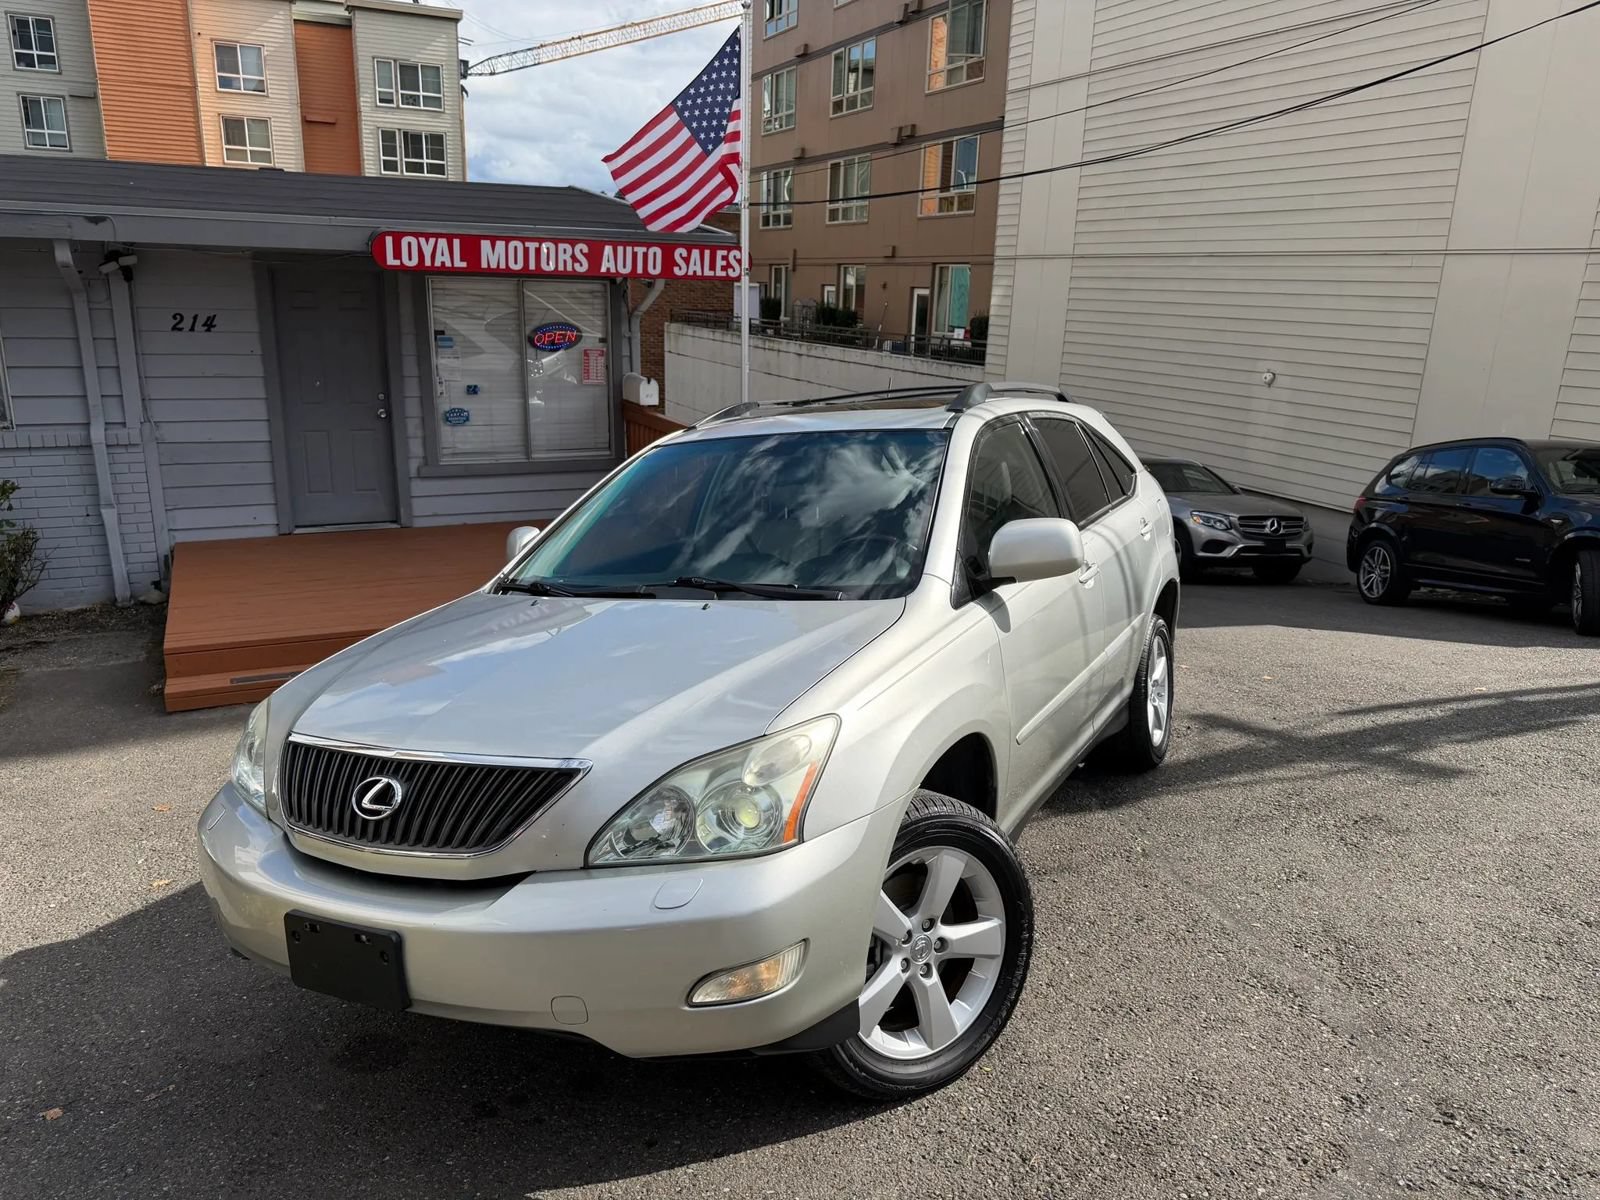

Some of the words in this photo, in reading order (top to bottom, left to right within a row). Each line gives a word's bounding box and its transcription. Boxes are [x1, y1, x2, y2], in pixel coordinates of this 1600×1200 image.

[385, 236, 467, 268] LOYAL
[480, 239, 589, 273] MOTORS
[600, 245, 662, 275] AUTO
[673, 248, 741, 278] SALES
[171, 312, 217, 333] 214
[534, 330, 577, 346] OPEN
